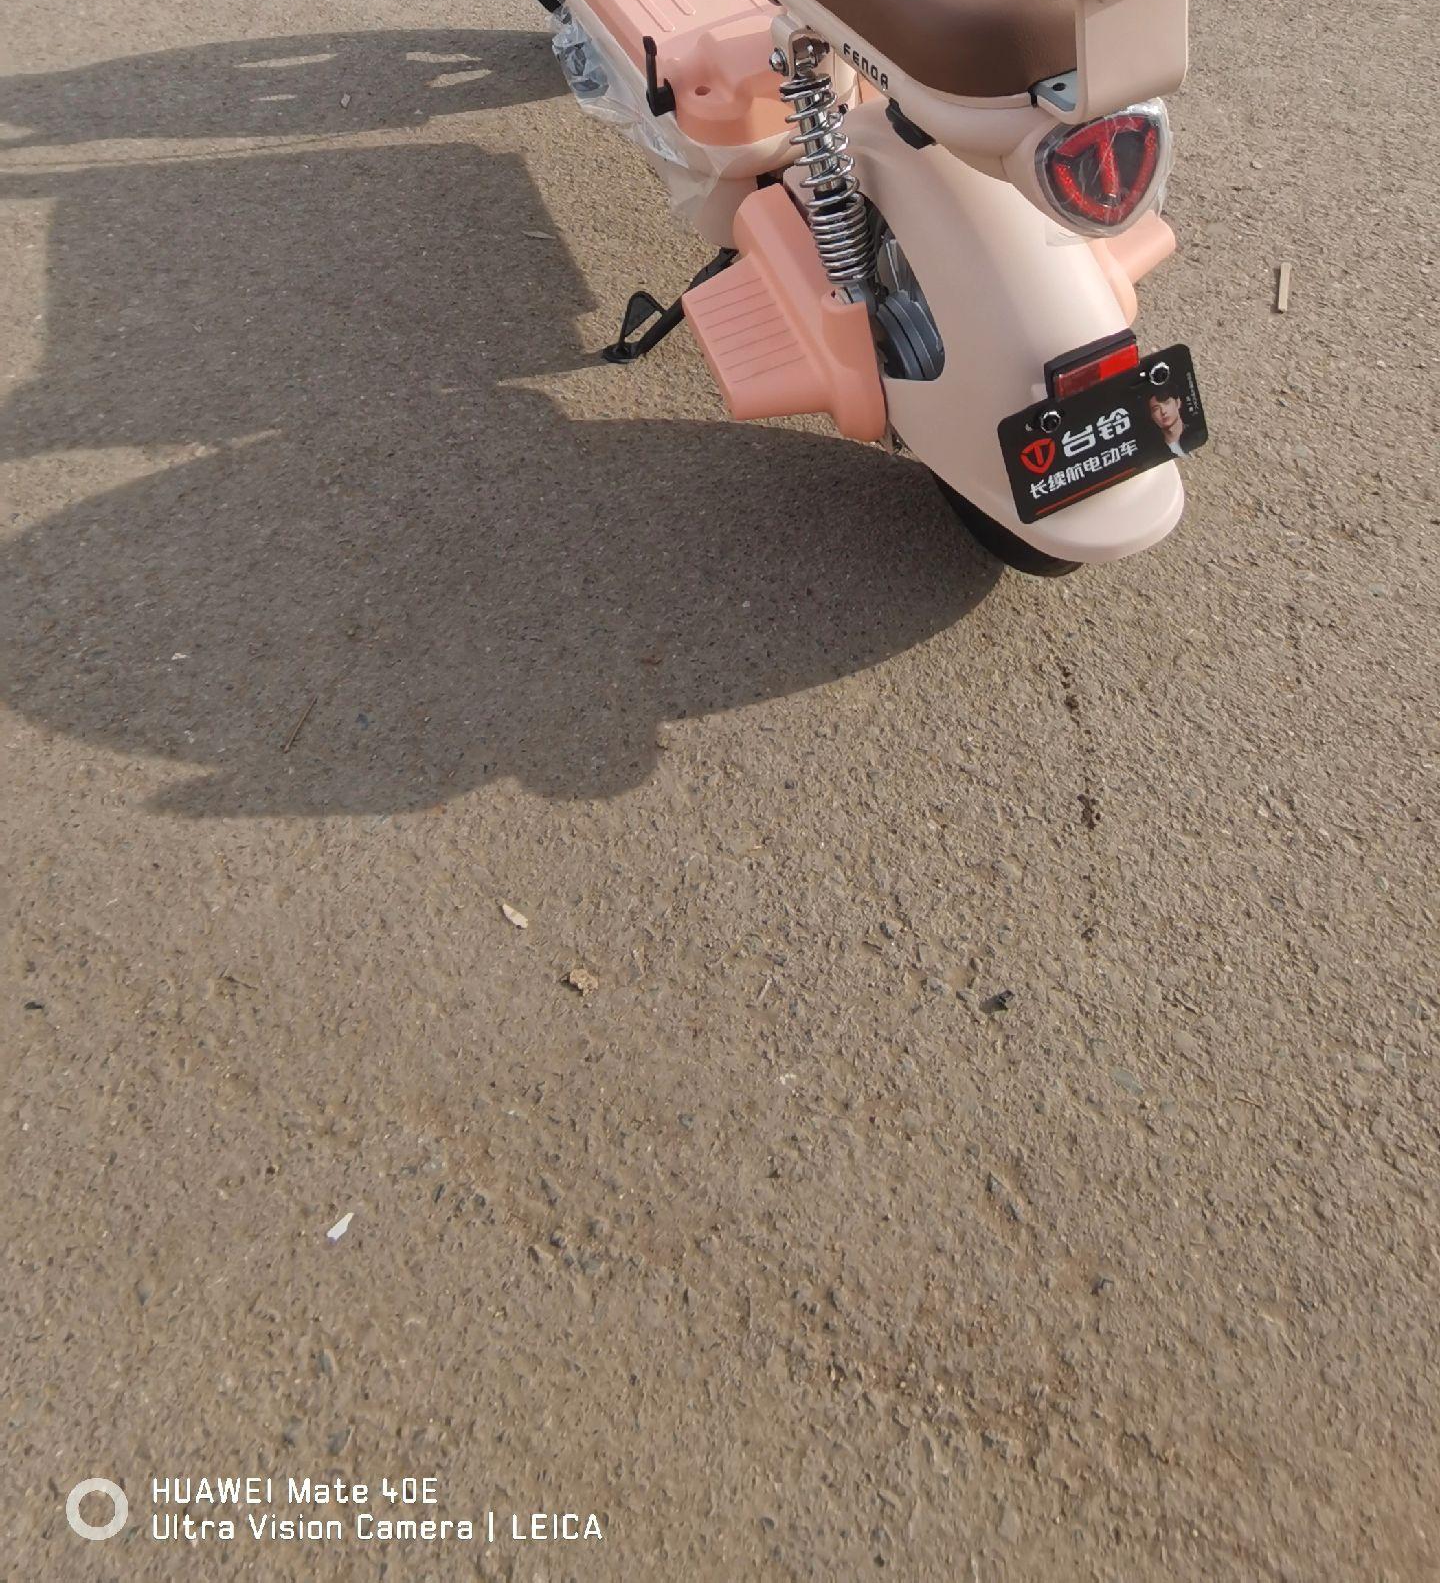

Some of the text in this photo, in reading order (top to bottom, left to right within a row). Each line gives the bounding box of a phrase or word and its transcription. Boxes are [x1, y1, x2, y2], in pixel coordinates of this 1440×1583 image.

[1061, 407, 1131, 457] 台铃
[1029, 439, 1138, 499] 长续航电动车
